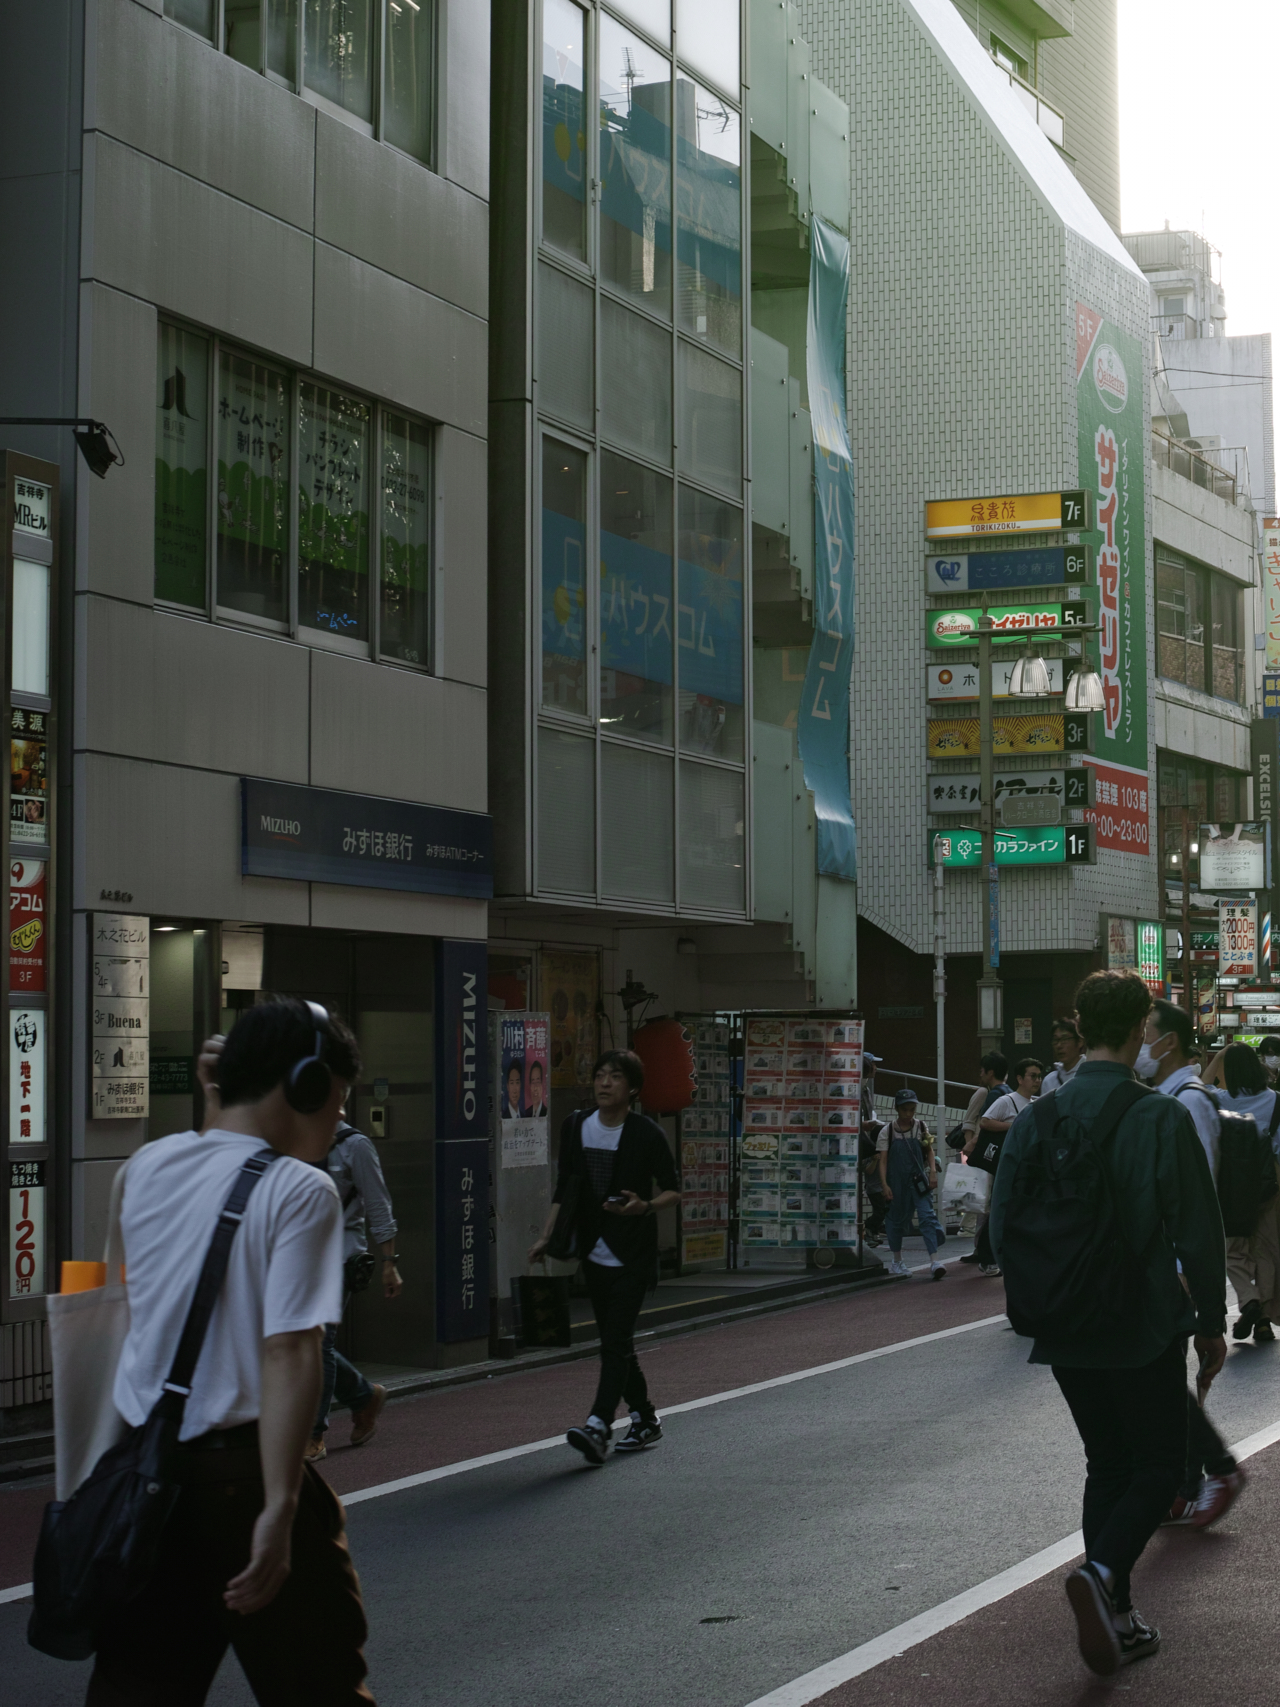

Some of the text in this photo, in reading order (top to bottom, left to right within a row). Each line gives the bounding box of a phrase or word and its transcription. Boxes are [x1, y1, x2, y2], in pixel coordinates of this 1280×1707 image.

[1078, 318, 1094, 340] 5F
[237, 430, 266, 459] 制作
[318, 430, 351, 457] チラシ
[17, 483, 45, 500] 吉祥寺
[14, 502, 47, 531] MRビル
[1064, 501, 1082, 521] 7F
[971, 522, 1016, 532] TORIKIZOKU
[974, 561, 1056, 578] こころ診療所
[1066, 556, 1084, 573] 6F
[1096, 424, 1121, 739] サイゼリヤ
[608, 576, 716, 657] ハウスコム
[935, 621, 971, 636] Saizeriya
[1067, 723, 1084, 743] 3F
[1068, 778, 1086, 798] 2F
[1017, 802, 1046, 811] 吉祥寺
[1121, 786, 1147, 813] 103席
[10, 804, 23, 818] 4F
[260, 814, 301, 836] MIZUHO
[342, 826, 413, 861] みずほ銀行
[425, 842, 485, 863] みずほATMコーナー
[1069, 834, 1086, 855] 1F
[10, 892, 43, 912] アコム
[1226, 907, 1250, 918] 理髪
[97, 927, 147, 943] 木之花ビル
[1226, 917, 1255, 934] 2000円
[1227, 934, 1255, 951] 1300円
[1222, 951, 1254, 961] ことぶき
[19, 971, 32, 982] 3F
[1231, 965, 1243, 974] 3F
[94, 1009, 142, 1029] 3F Buena
[462, 971, 477, 1121] MIZUHO
[503, 1027, 525, 1050] 川村
[94, 1049, 106, 1065] 2F
[20, 1060, 31, 1138] 地下一階
[107, 1082, 145, 1097] みずほ銀行
[11, 1162, 39, 1175] もつ焼き
[11, 1174, 39, 1186] 焼きとん
[461, 1166, 475, 1310] みずほ銀行
